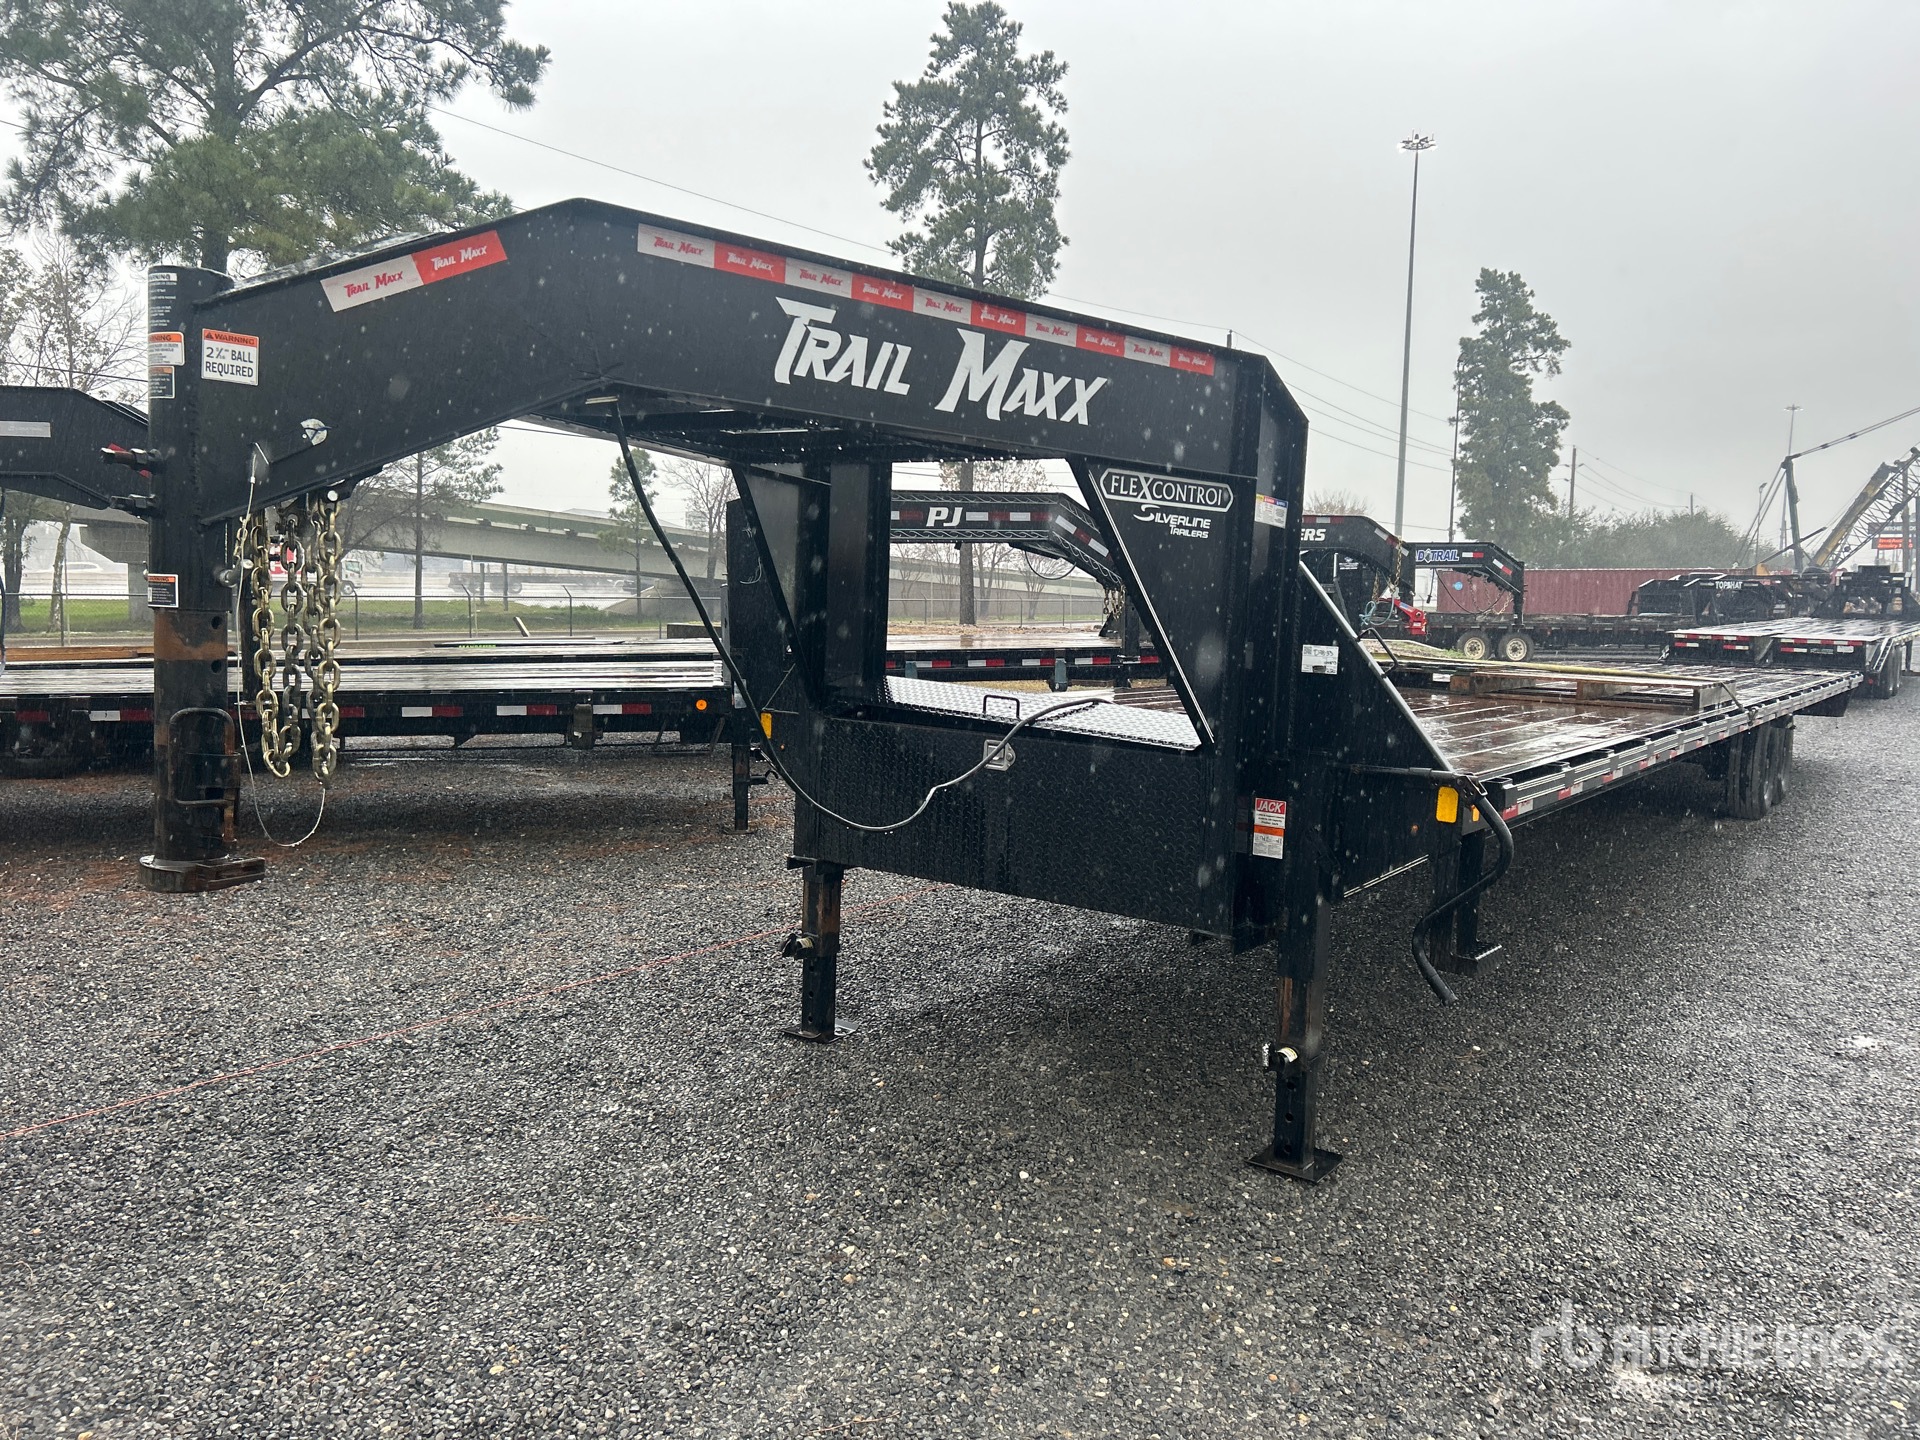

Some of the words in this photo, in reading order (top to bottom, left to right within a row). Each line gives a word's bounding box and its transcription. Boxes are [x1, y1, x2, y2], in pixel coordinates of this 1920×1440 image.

[654, 236, 674, 250] TRAIL
[677, 241, 705, 255] MAXX
[431, 257, 456, 271] TRAIL
[459, 245, 488, 263] MAXX
[727, 252, 747, 266] TRAIL
[749, 257, 775, 271] MAXX
[344, 283, 370, 298] TRAIL
[374, 271, 404, 289] MAXX
[799, 269, 817, 282] TRAIL
[820, 272, 843, 287] MAXX
[862, 283, 880, 296] TRAIL
[882, 287, 904, 300] MAXX
[925, 297, 941, 309] TRAIL
[943, 301, 963, 314] MAXX
[215, 333, 255, 345] WARNING
[231, 349, 254, 363] BALL
[774, 296, 912, 396] TRAIL
[934, 327, 1108, 426] MAXX
[205, 361, 254, 378] REQUIRED
[926, 506, 963, 527] PJ
[1133, 504, 1212, 529] SILVERLINE
[1169, 524, 1209, 539] TRAILERS
[1430, 549, 1460, 562] TRAIL
[1258, 801, 1283, 813] JACK
